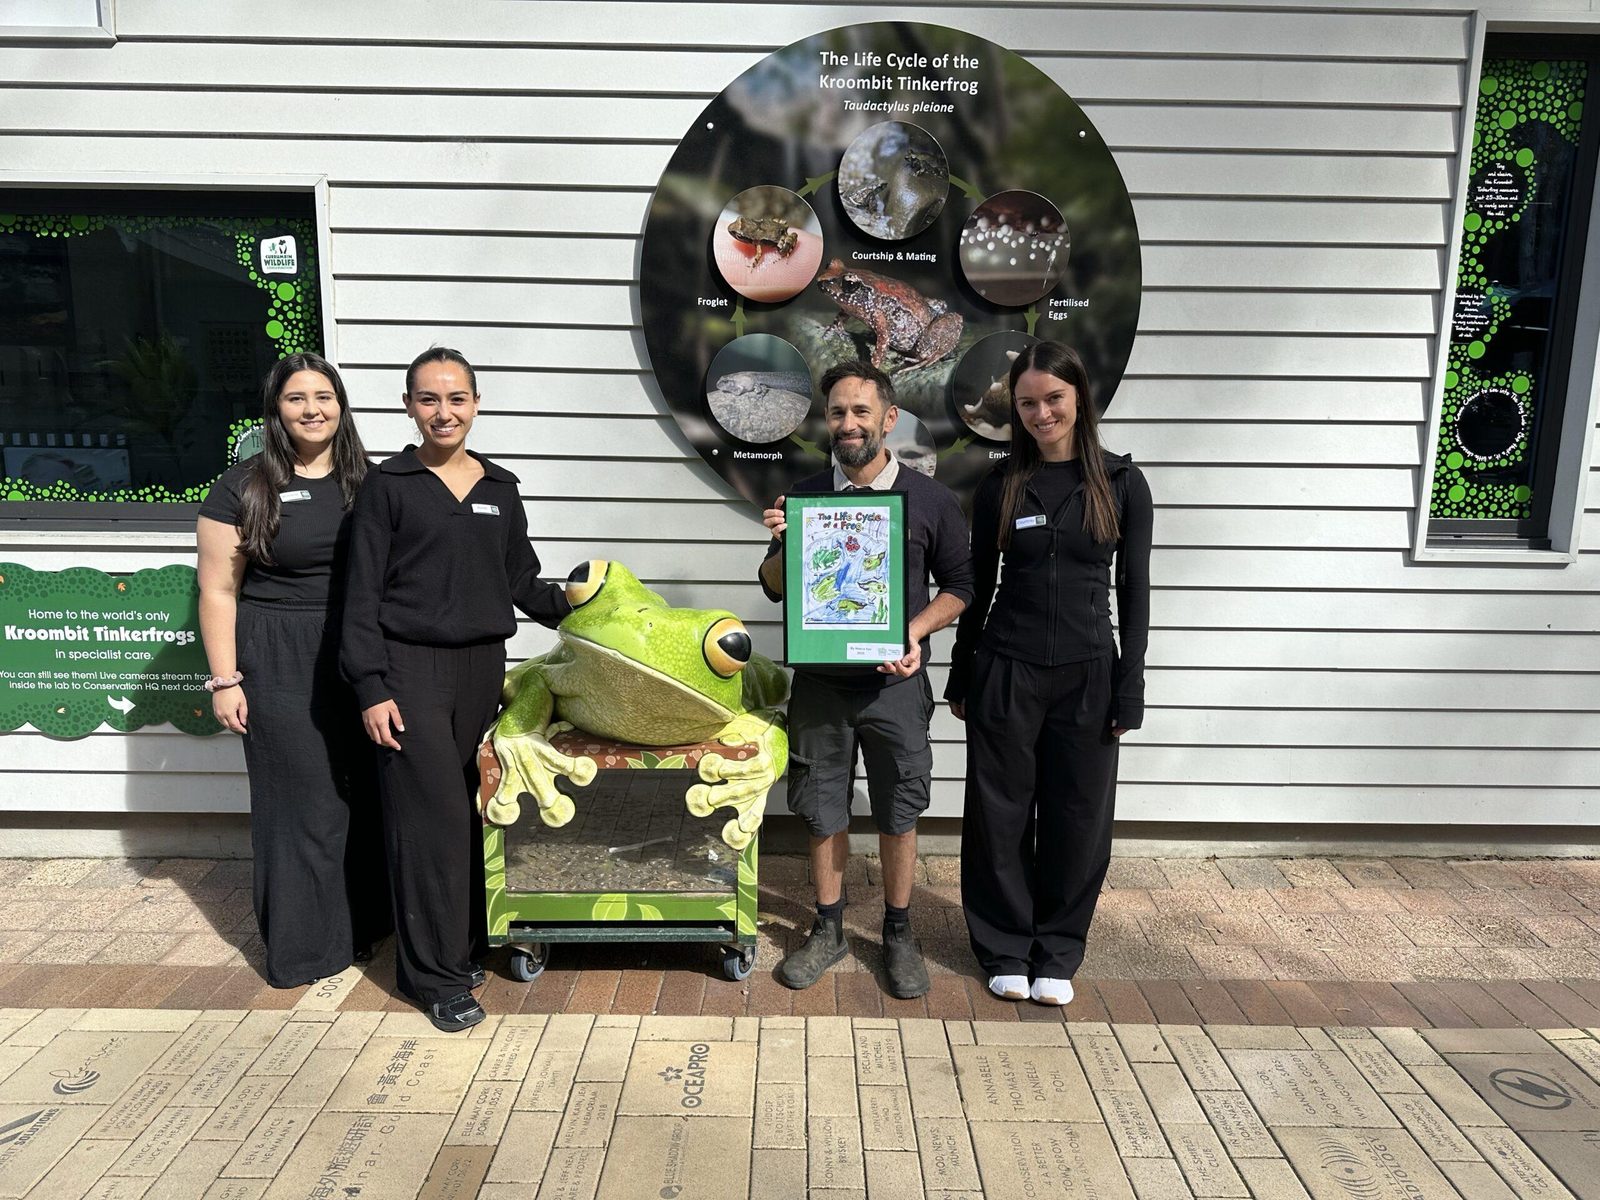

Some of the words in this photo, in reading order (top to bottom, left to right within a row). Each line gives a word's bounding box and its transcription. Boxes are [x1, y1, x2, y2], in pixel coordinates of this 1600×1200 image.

[820, 52, 848, 66] The
[854, 52, 881, 66] Life
[887, 53, 927, 70] Cycle
[932, 54, 948, 68] of
[953, 54, 979, 69] the
[820, 75, 892, 90] Kroombit
[898, 76, 978, 95] Tinkerfrog
[844, 100, 910, 113] Taudactylus
[912, 102, 954, 114] pleione
[852, 251, 893, 262] Courtship
[896, 252, 904, 261] &
[906, 252, 936, 263] Mating
[697, 297, 728, 308] Froglet
[1050, 298, 1089, 308] Fertilised
[1049, 311, 1067, 320] Eggs
[733, 450, 783, 462] Metamorph
[834, 512, 852, 521] Life
[856, 512, 881, 523] Cycle
[29, 609, 63, 620] Home
[66, 610, 77, 620] to
[81, 610, 99, 620] the
[102, 611, 142, 620] world's
[146, 611, 170, 622] only
[5, 625, 89, 641] Kroombit
[93, 626, 195, 646] Tinkerfrogs
[56, 649, 65, 658] in
[69, 650, 121, 662] specialist
[125, 651, 154, 660] care.
[55, 681, 69, 689] lab
[83, 682, 142, 690] Conservation
[72, 671, 97, 680] them!
[316, 978, 343, 998] 500
[859, 1035, 867, 1048] AND
[874, 1040, 883, 1068] MITCHELL
[887, 1055, 896, 1072] WATT
[997, 1051, 1012, 1067] AND
[1289, 1053, 1314, 1076] GOLDY
[1310, 1053, 1336, 1075] WONG
[403, 1048, 440, 1086] Coast
[487, 1058, 504, 1077] CARRIE
[679, 1043, 710, 1108] OCEAPRO
[189, 1078, 210, 1095] ABBY
[976, 1055, 1000, 1104] ANNABELLE
[1022, 1060, 1046, 1100] DANIELLA
[1048, 1070, 1066, 1092] POHL
[1003, 1071, 1025, 1110] THOMAS
[1202, 1094, 1216, 1103] OF
[1330, 1079, 1356, 1102] NGOH
[213, 1112, 234, 1128] BART
[235, 1085, 255, 1101] JODY
[227, 1102, 256, 1130] INFINITE
[251, 1082, 271, 1099] LOVE
[460, 1122, 476, 1136] ELLIE
[468, 1106, 484, 1119] MAY
[476, 1086, 493, 1103] CORK
[473, 1116, 491, 1135] BORN
[483, 1088, 504, 1114] 01.05.20
[595, 1104, 609, 1119] 2018
[1126, 1101, 1142, 1118] 2019
[1218, 1099, 1240, 1118] NASH
[11, 1108, 61, 1144] SOLUTIONS
[1135, 1121, 1151, 1139] SKYE
[1209, 1106, 1235, 1136] MEMORY
[1233, 1121, 1254, 1140] JOAN
[124, 1144, 154, 1169] PATRICK
[150, 1109, 185, 1140] HERMANN
[144, 1148, 165, 1164] LUCK
[167, 1115, 194, 1138] HEALTH
[241, 1150, 260, 1165] BEN
[260, 1117, 284, 1139] JOYCE
[259, 1126, 292, 1162] NEWMAN
[1064, 1124, 1082, 1153] ROHAN
[1123, 1126, 1142, 1150] HAPPY
[1228, 1138, 1242, 1147] IN
[838, 1136, 846, 1162] BRISKEY
[946, 1135, 961, 1165] MUNICH
[1032, 1142, 1048, 1168] BETTER
[1495, 1137, 1534, 1170] SIMONSEN
[1009, 1131, 1035, 1197] CONSERVATION
[1048, 1138, 1074, 1190] TOMORROW
[1074, 1156, 1089, 1173] AND
[1196, 1166, 1212, 1181] THE
[1505, 1161, 1542, 1193] GRATEFUL
